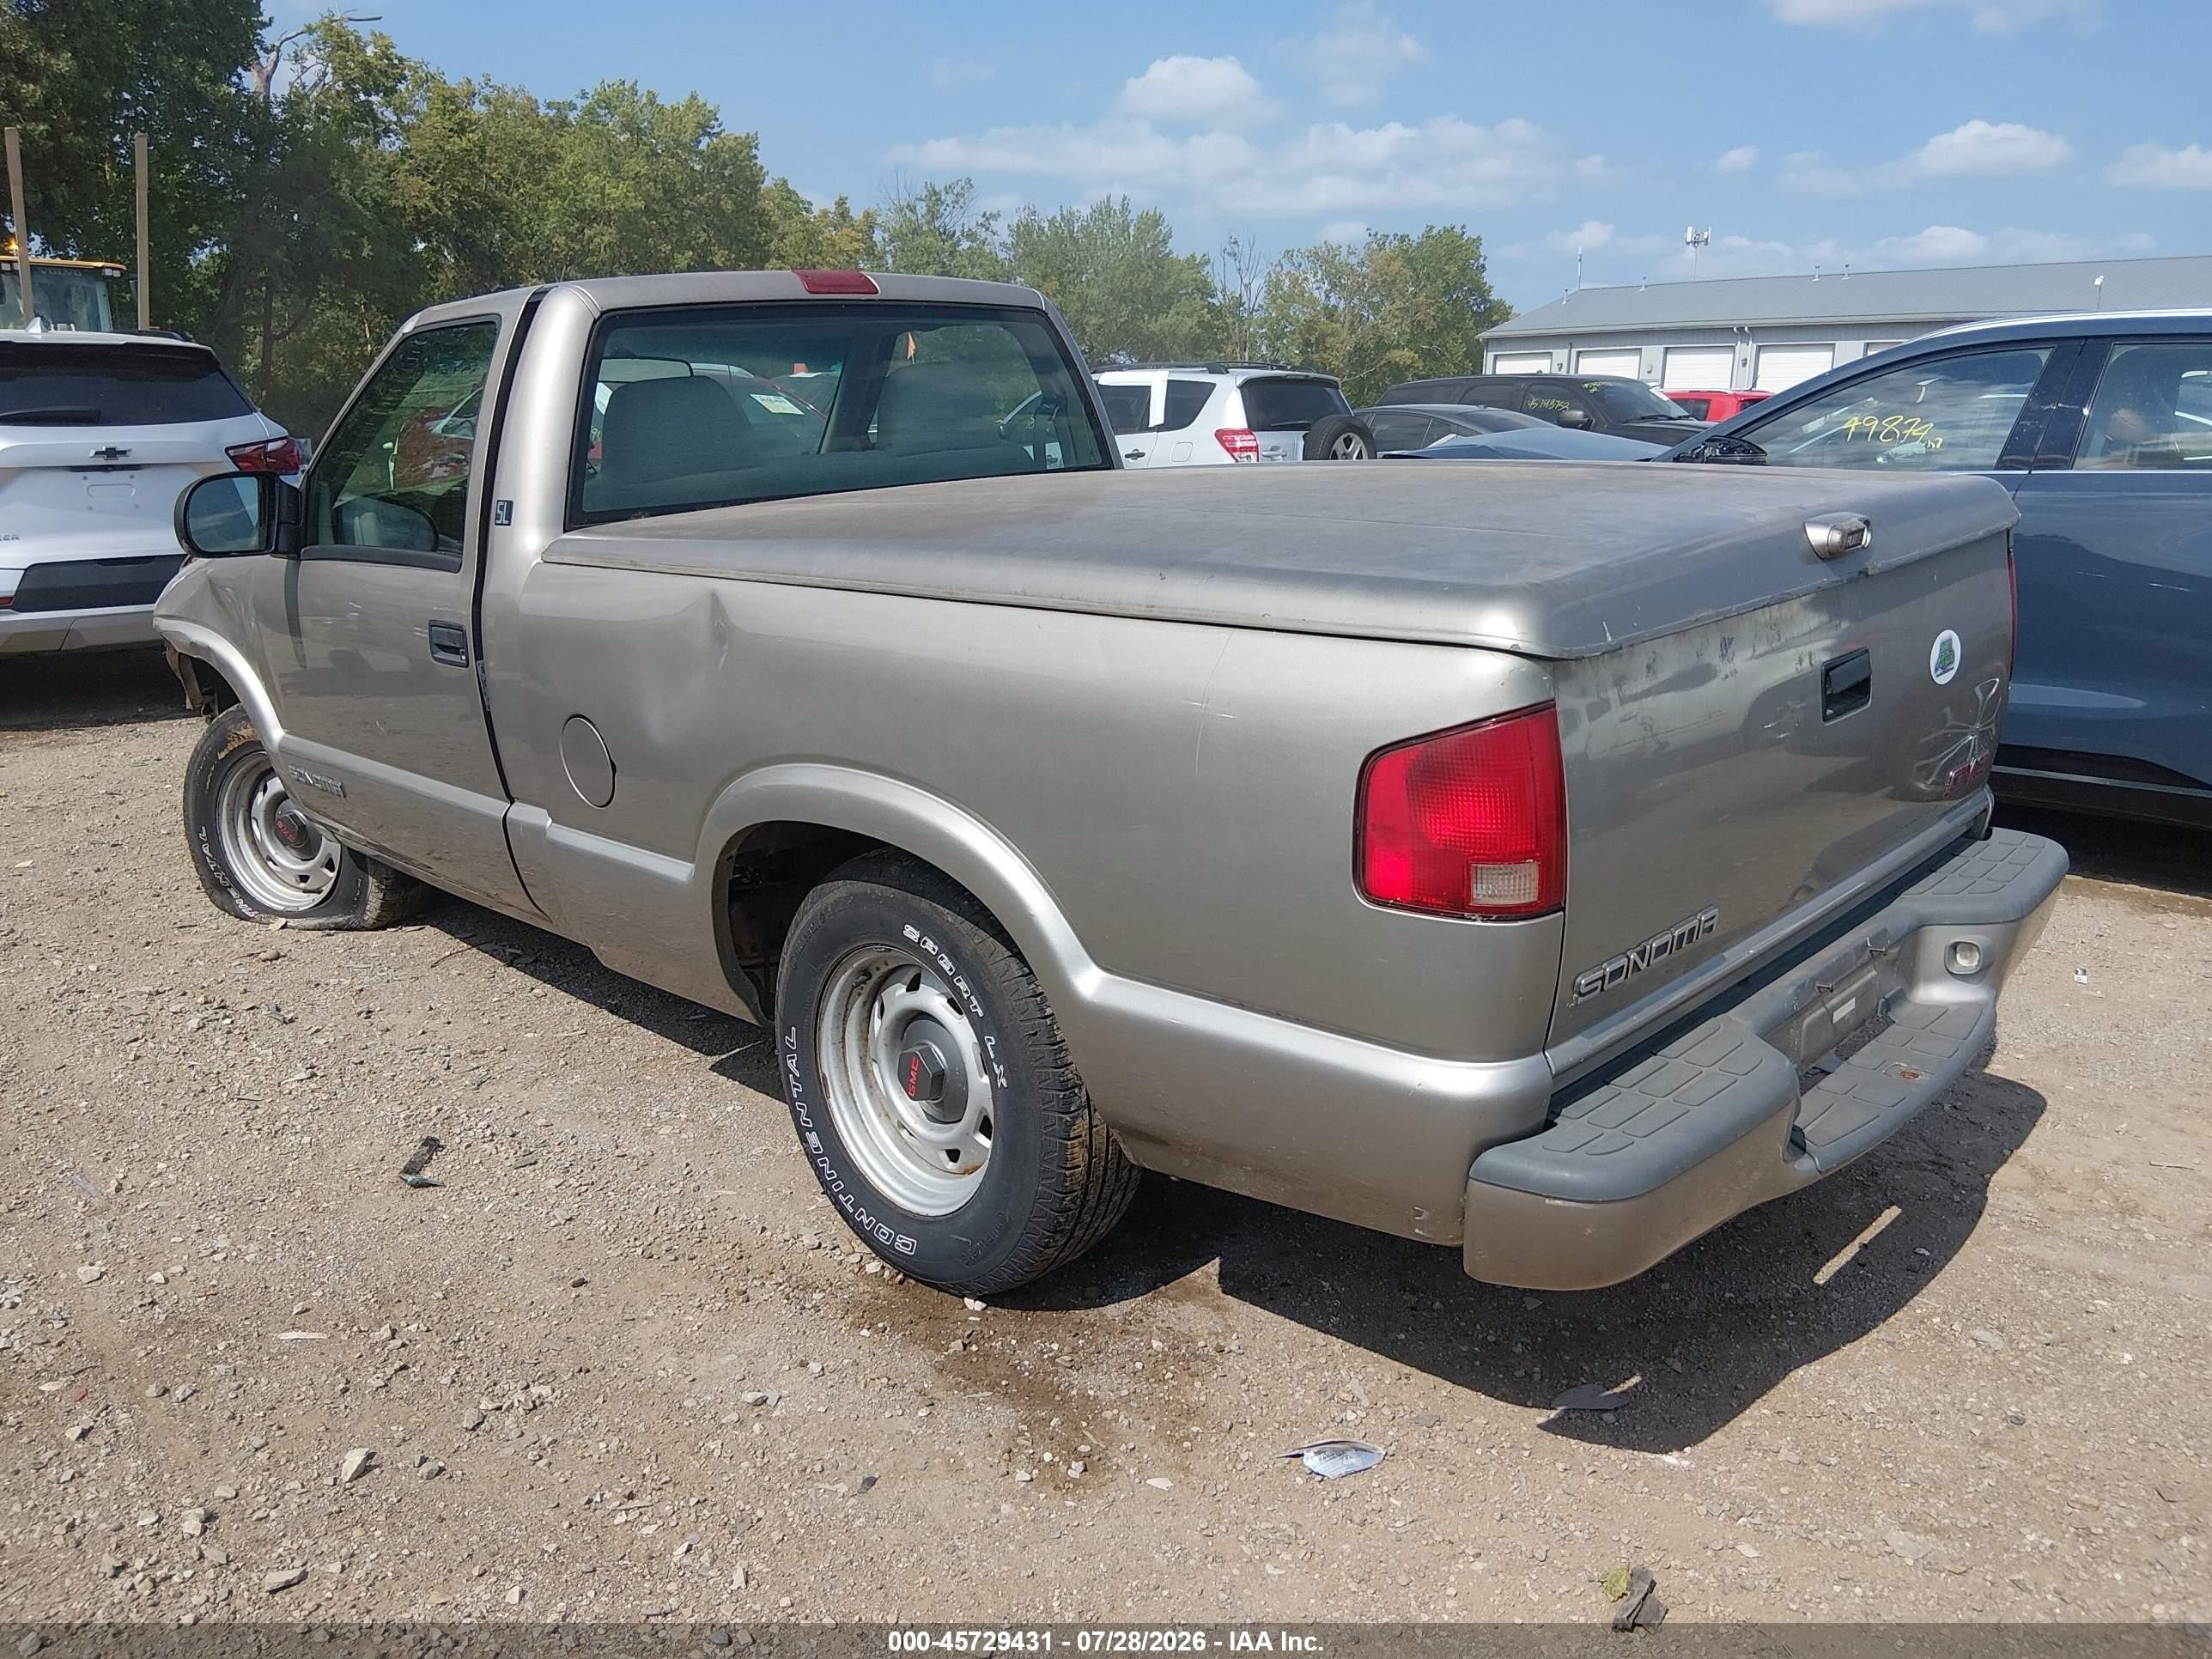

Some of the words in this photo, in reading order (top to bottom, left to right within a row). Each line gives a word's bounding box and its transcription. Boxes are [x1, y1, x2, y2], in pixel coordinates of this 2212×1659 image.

[902, 923, 984, 1018] SPORT
[984, 1036, 1009, 1089] LX
[1574, 905, 1718, 1005] SONOMA
[785, 1025, 918, 1255] CONTINENTAL
[908, 1056, 920, 1097] GMC
